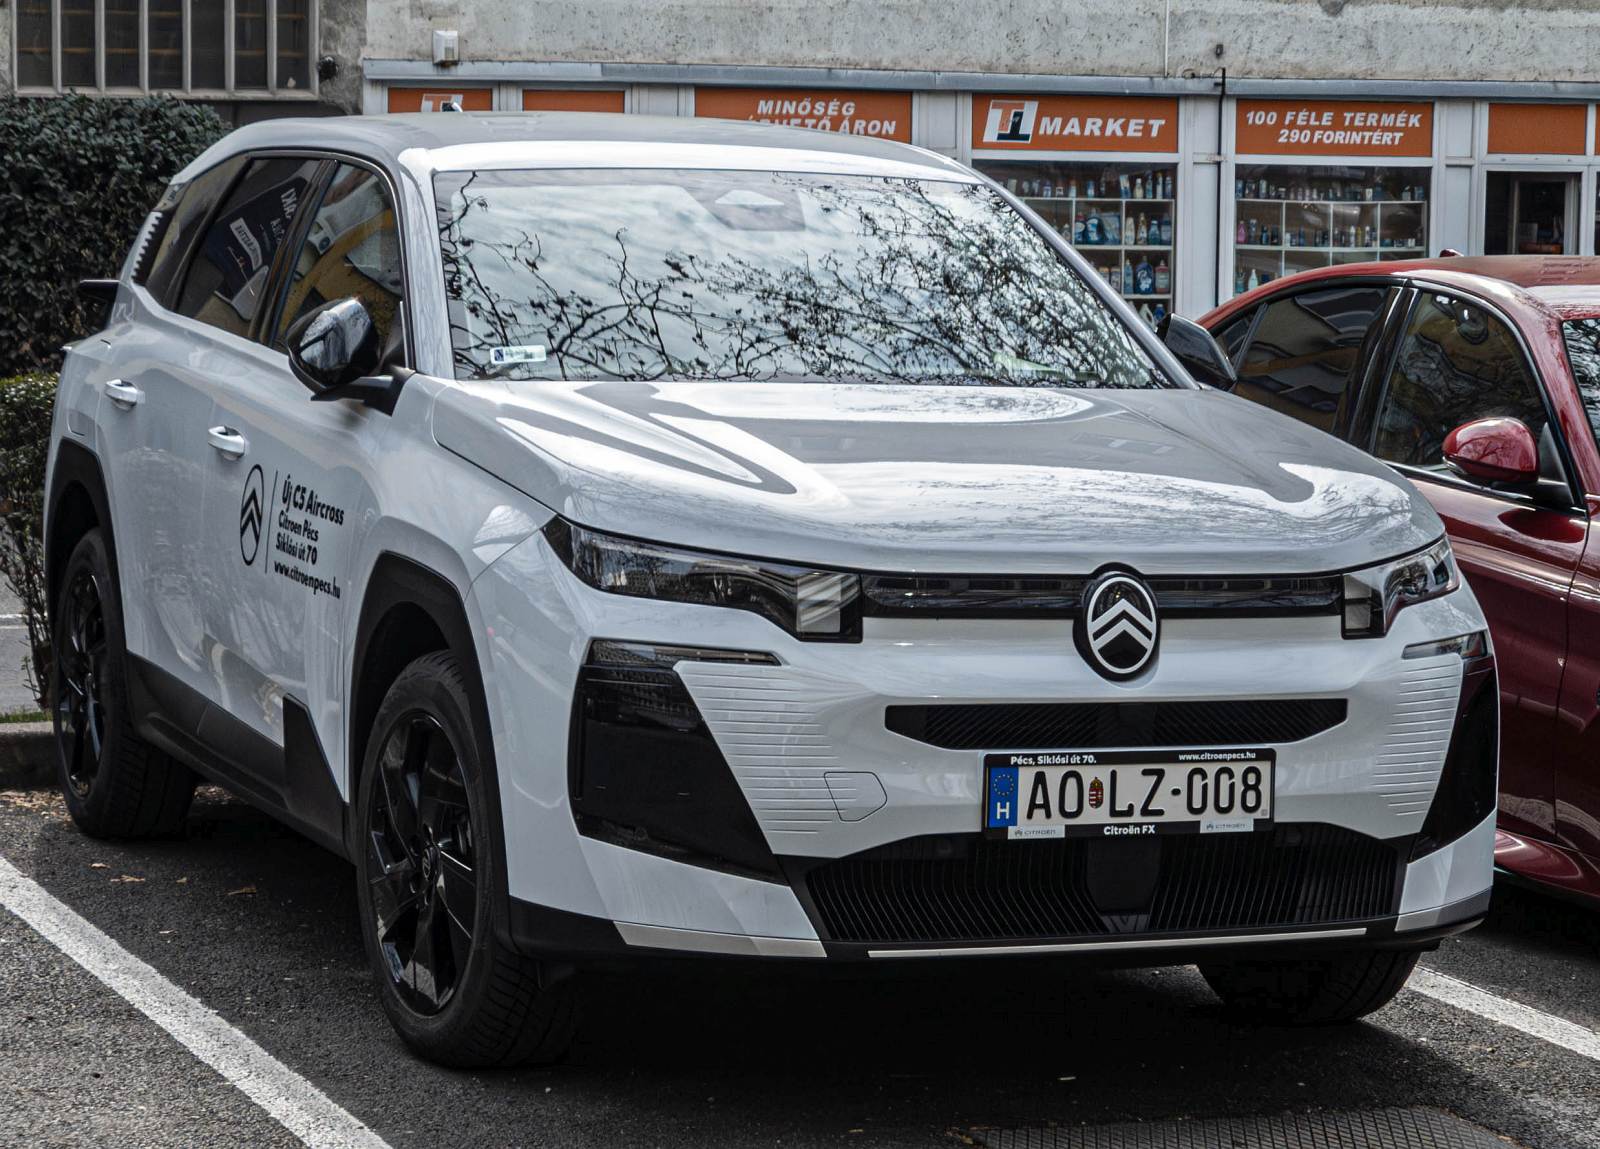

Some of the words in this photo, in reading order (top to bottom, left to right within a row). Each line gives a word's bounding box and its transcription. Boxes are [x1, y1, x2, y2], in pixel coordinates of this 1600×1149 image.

[757, 98, 856, 116] MINŐSÉG
[838, 116, 896, 135] ÁRON
[1038, 116, 1166, 138] MARKET
[1246, 110, 1277, 125] 100
[1284, 108, 1334, 126] FÉLE
[1343, 110, 1422, 128] TERMÉK
[1278, 129, 1311, 144] 290
[1312, 129, 1404, 146] FORINTÉRT
[281, 474, 293, 513] Új
[292, 484, 307, 511] C5
[305, 489, 345, 526] Aircross
[302, 519, 319, 543] Pécs
[275, 531, 298, 557] Siklósi
[306, 544, 318, 566] 70
[273, 560, 341, 600] www.citroenpecs.hu
[1037, 754, 1069, 765] Siklósi
[1082, 754, 1097, 764] 70.
[1178, 751, 1257, 761] www.citroenpecs.hu
[1026, 770, 1085, 820] AO
[1109, 765, 1262, 818] LZ-008
[996, 801, 1011, 820] H
[1103, 823, 1141, 836] Citroën
[1142, 823, 1156, 834] FX
